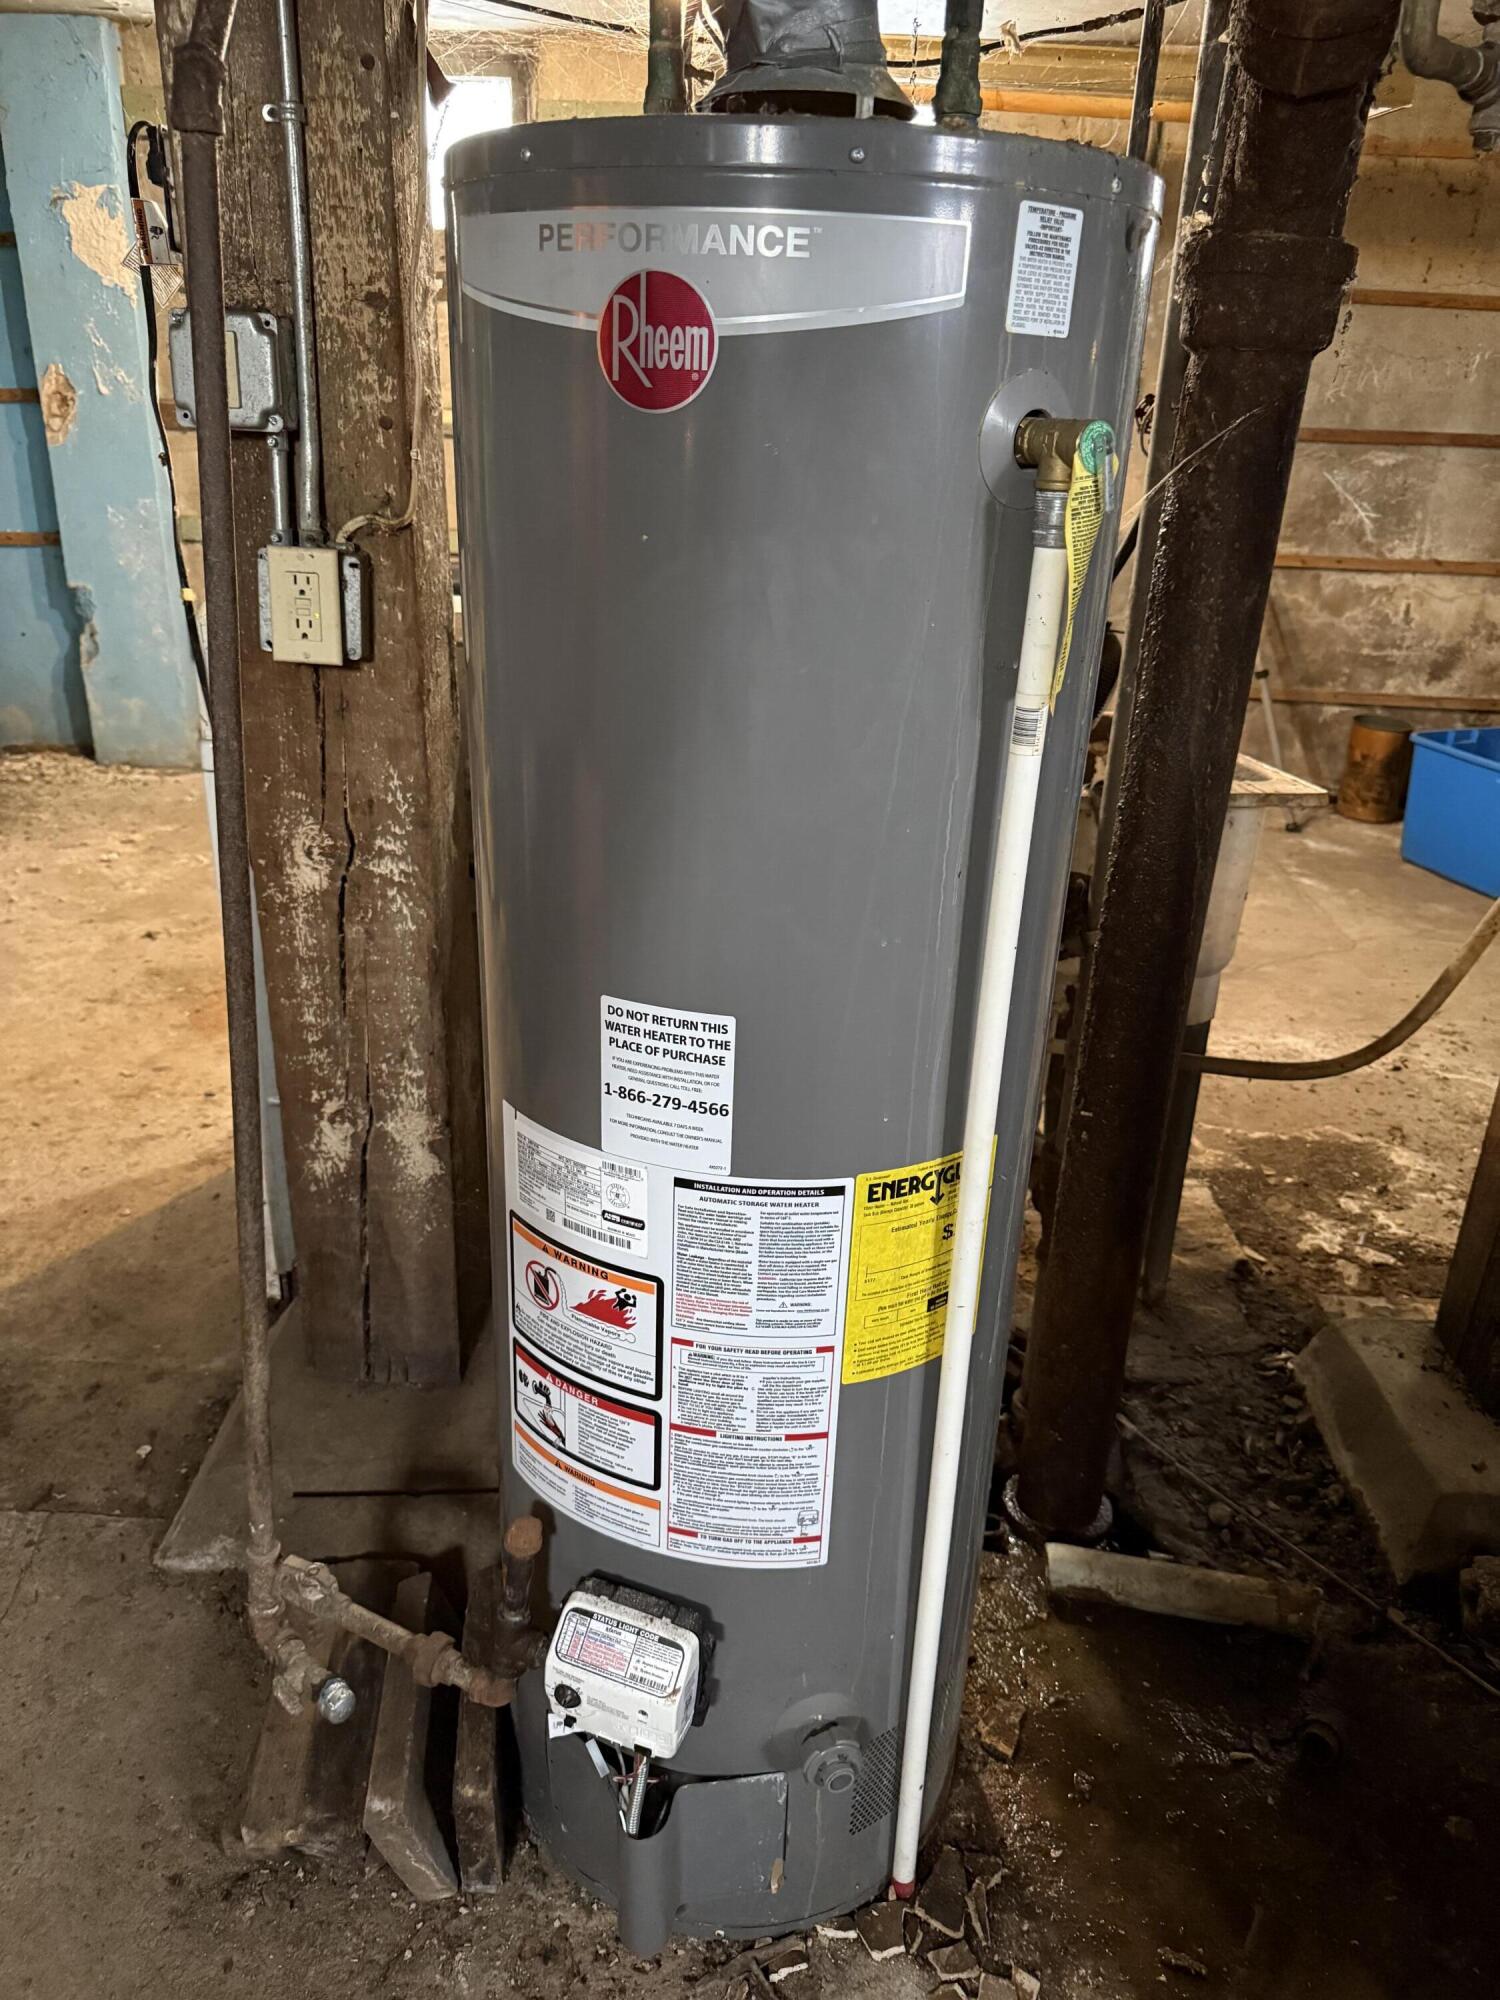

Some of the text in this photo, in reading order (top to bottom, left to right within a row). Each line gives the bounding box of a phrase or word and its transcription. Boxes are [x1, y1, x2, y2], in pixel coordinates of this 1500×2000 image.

[539, 222, 811, 258] PERFORMANCE
[612, 269, 709, 388] Rheem
[607, 1005, 728, 1034] DO NOT RETURN THIS
[605, 1019, 731, 1051] WATER HEATER TO THE
[609, 1036, 726, 1066] PLACE OF PURCHASE
[604, 1082, 729, 1117] 1-866-279-4566
[693, 1183, 740, 1194] INSTALLATION
[699, 1196, 737, 1206] AUTOMATIC
[738, 1200, 768, 1208] STORAGE
[891, 1221, 918, 1233] Estimated
[554, 1250, 609, 1281] WARNING
[539, 1311, 613, 1351] FIRE AND EXPLOSION HAZARD
[571, 1313, 621, 1338] Flammable Vapors
[580, 1341, 594, 1350] injury
[601, 1350, 616, 1359] death
[555, 1377, 599, 1406] DANGER
[564, 1465, 596, 1487] WARNING
[592, 1613, 660, 1643] STATUS LIGHT CODE
